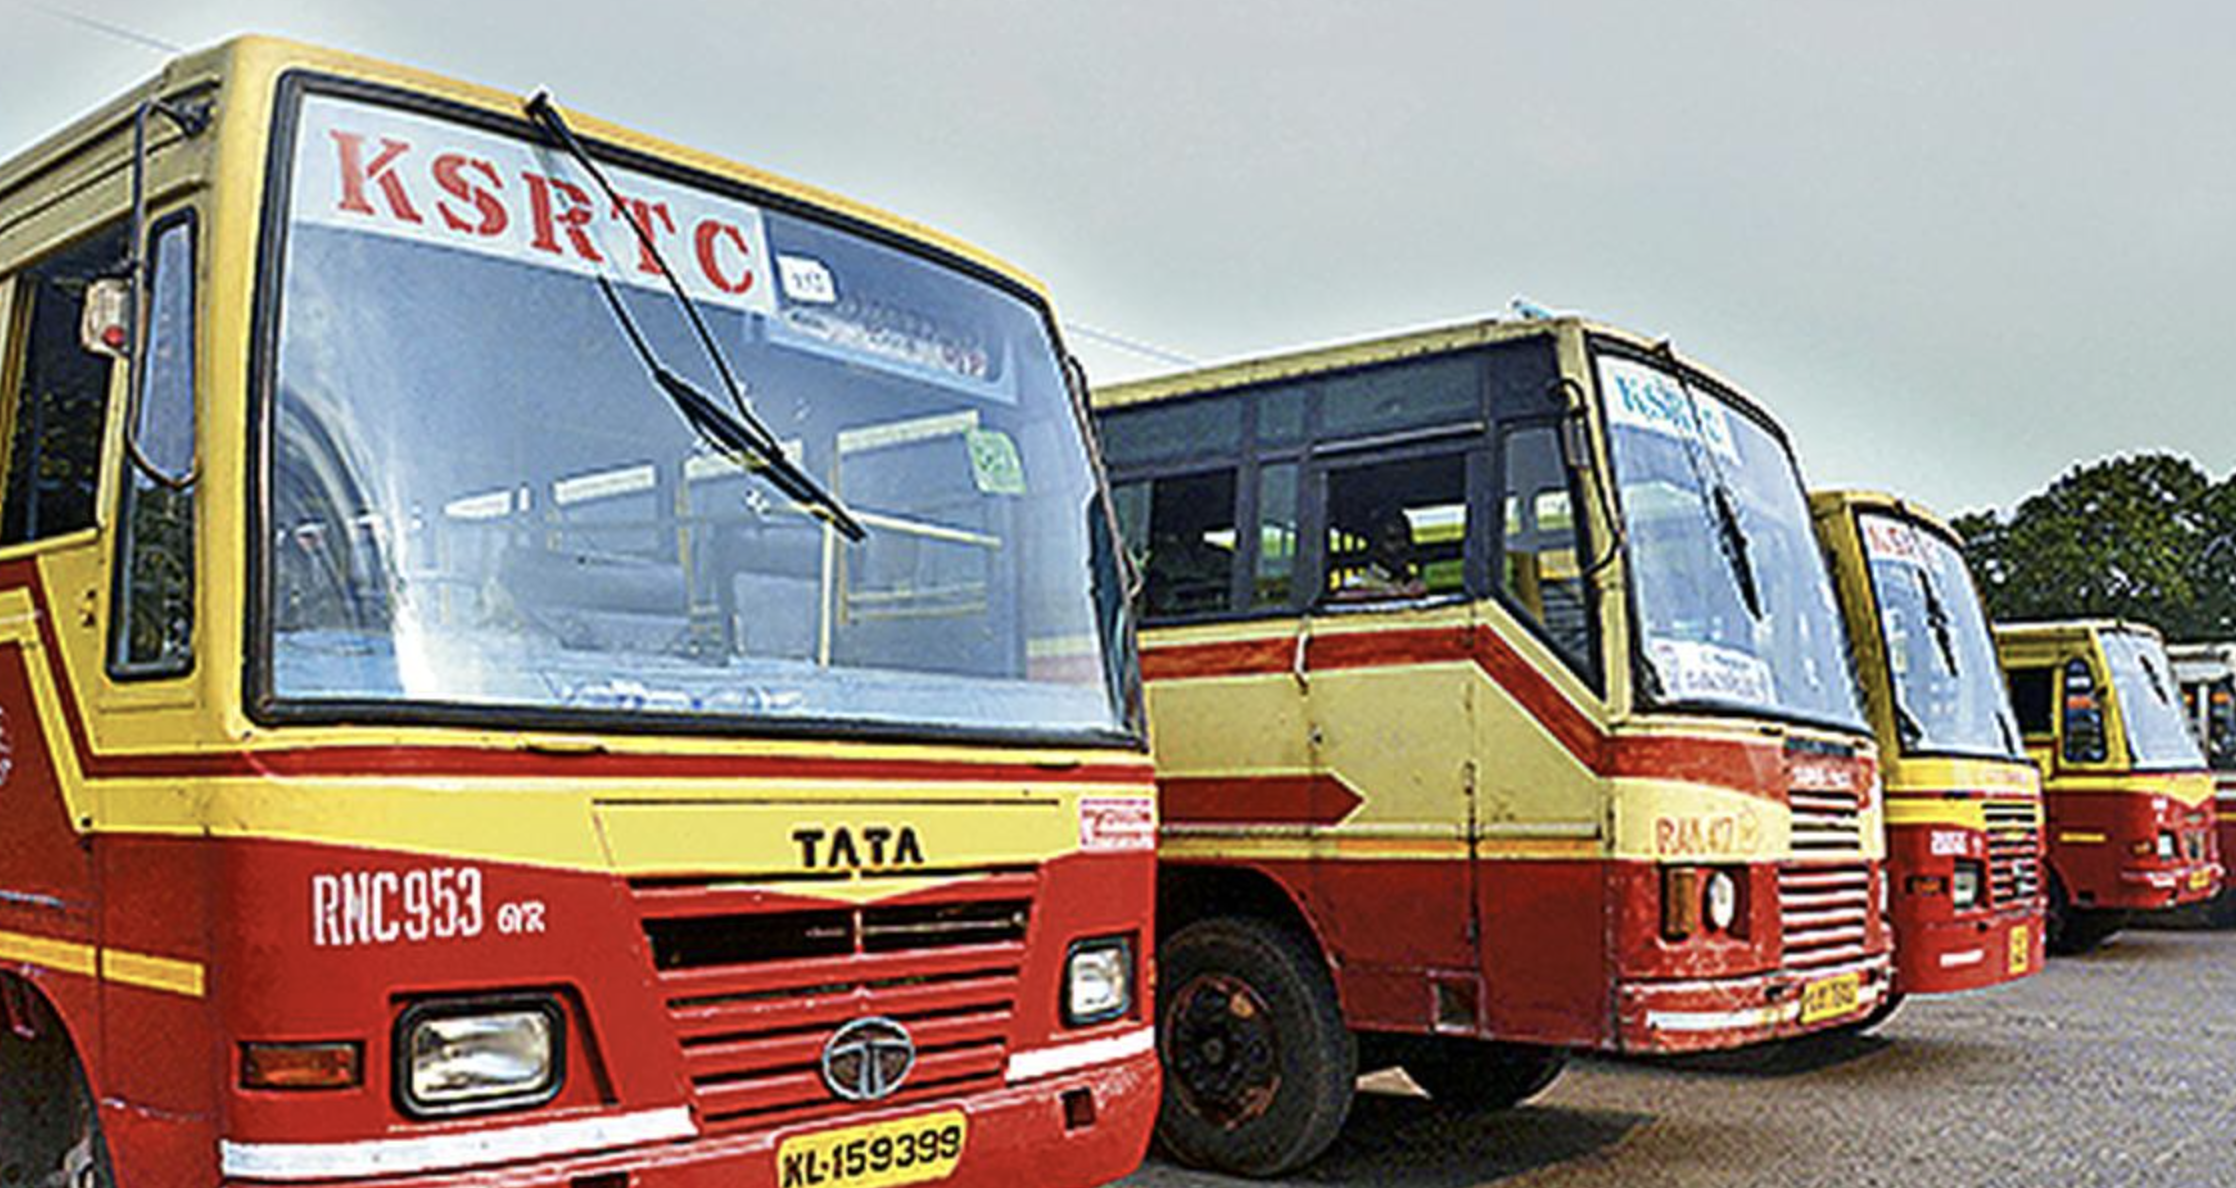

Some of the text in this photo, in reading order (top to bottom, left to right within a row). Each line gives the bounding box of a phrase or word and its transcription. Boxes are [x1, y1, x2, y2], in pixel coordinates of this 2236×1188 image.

[329, 129, 755, 295] KSRTC
[793, 827, 924, 868] TATA
[313, 867, 484, 946] RNC953
